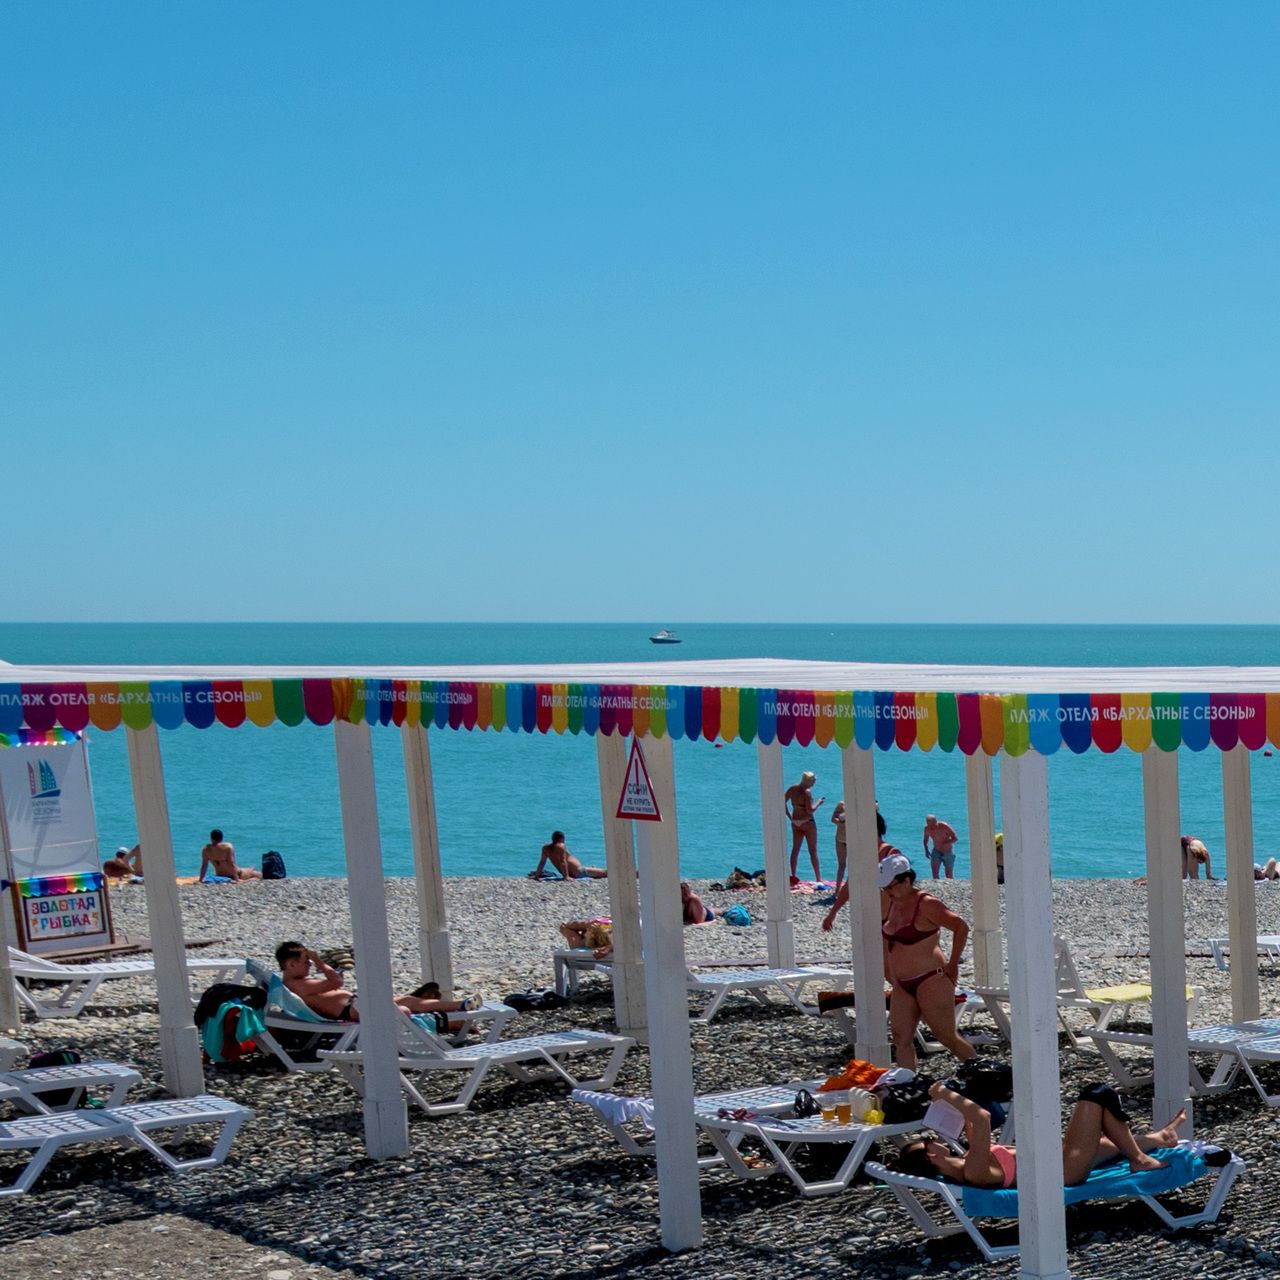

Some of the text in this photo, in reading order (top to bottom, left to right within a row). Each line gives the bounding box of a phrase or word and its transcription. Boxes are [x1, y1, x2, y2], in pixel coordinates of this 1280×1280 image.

[0, 691, 262, 707] ПЛЯЖ ОТЕЛЯ «БАРХАТНЫЕ СЕЗОНЫ»
[565, 695, 587, 708] ОТЕЛЯ
[764, 702, 929, 720] ПЛЯЖ ОТЕЛЯ «БАРХАТНЫЕ СЕЗОНЫ»
[1010, 705, 1255, 723] ПЛЯЖ ОТЕЛЯ «БАРХАТНЫЕ СЕЗОНЫ»
[31, 897, 96, 915] ЗОЛОТАЯ
[41, 913, 91, 930] РЫБКА
